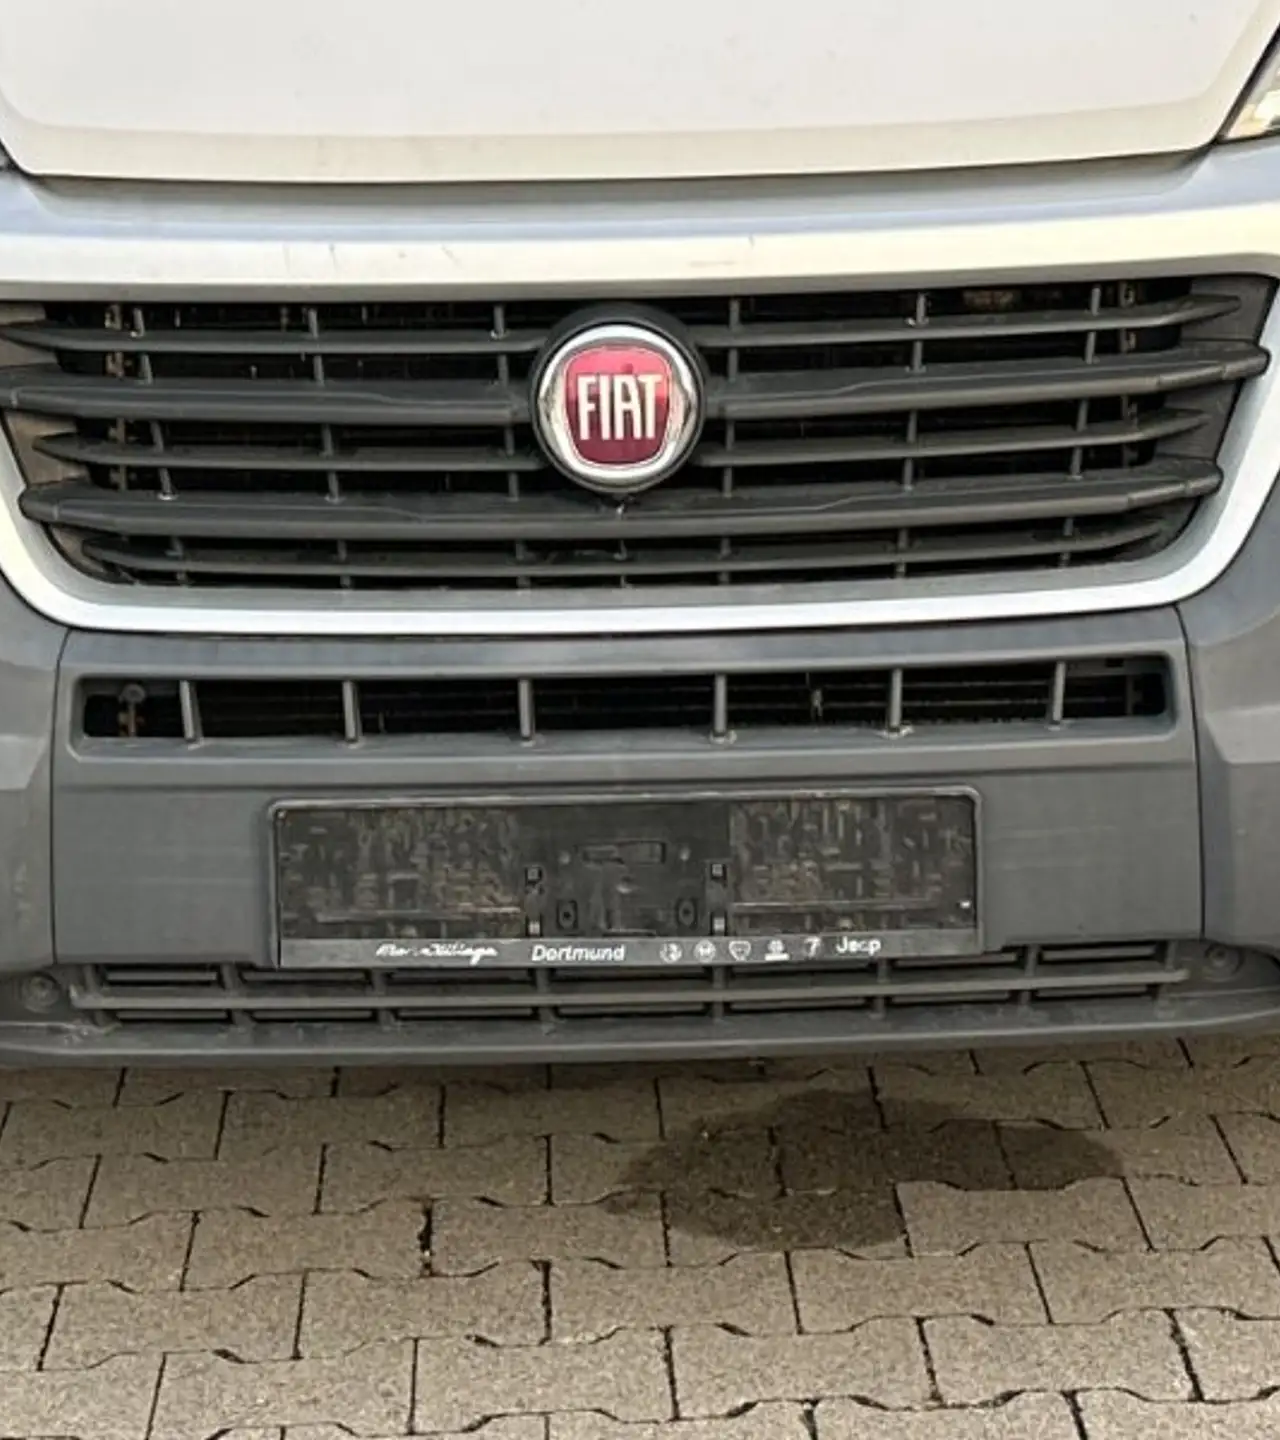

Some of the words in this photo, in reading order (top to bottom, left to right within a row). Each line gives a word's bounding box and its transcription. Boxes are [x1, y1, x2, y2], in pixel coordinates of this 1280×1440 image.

[577, 373, 662, 441] FIAT
[532, 943, 626, 962] Dortmund
[836, 935, 882, 957] Jeep
